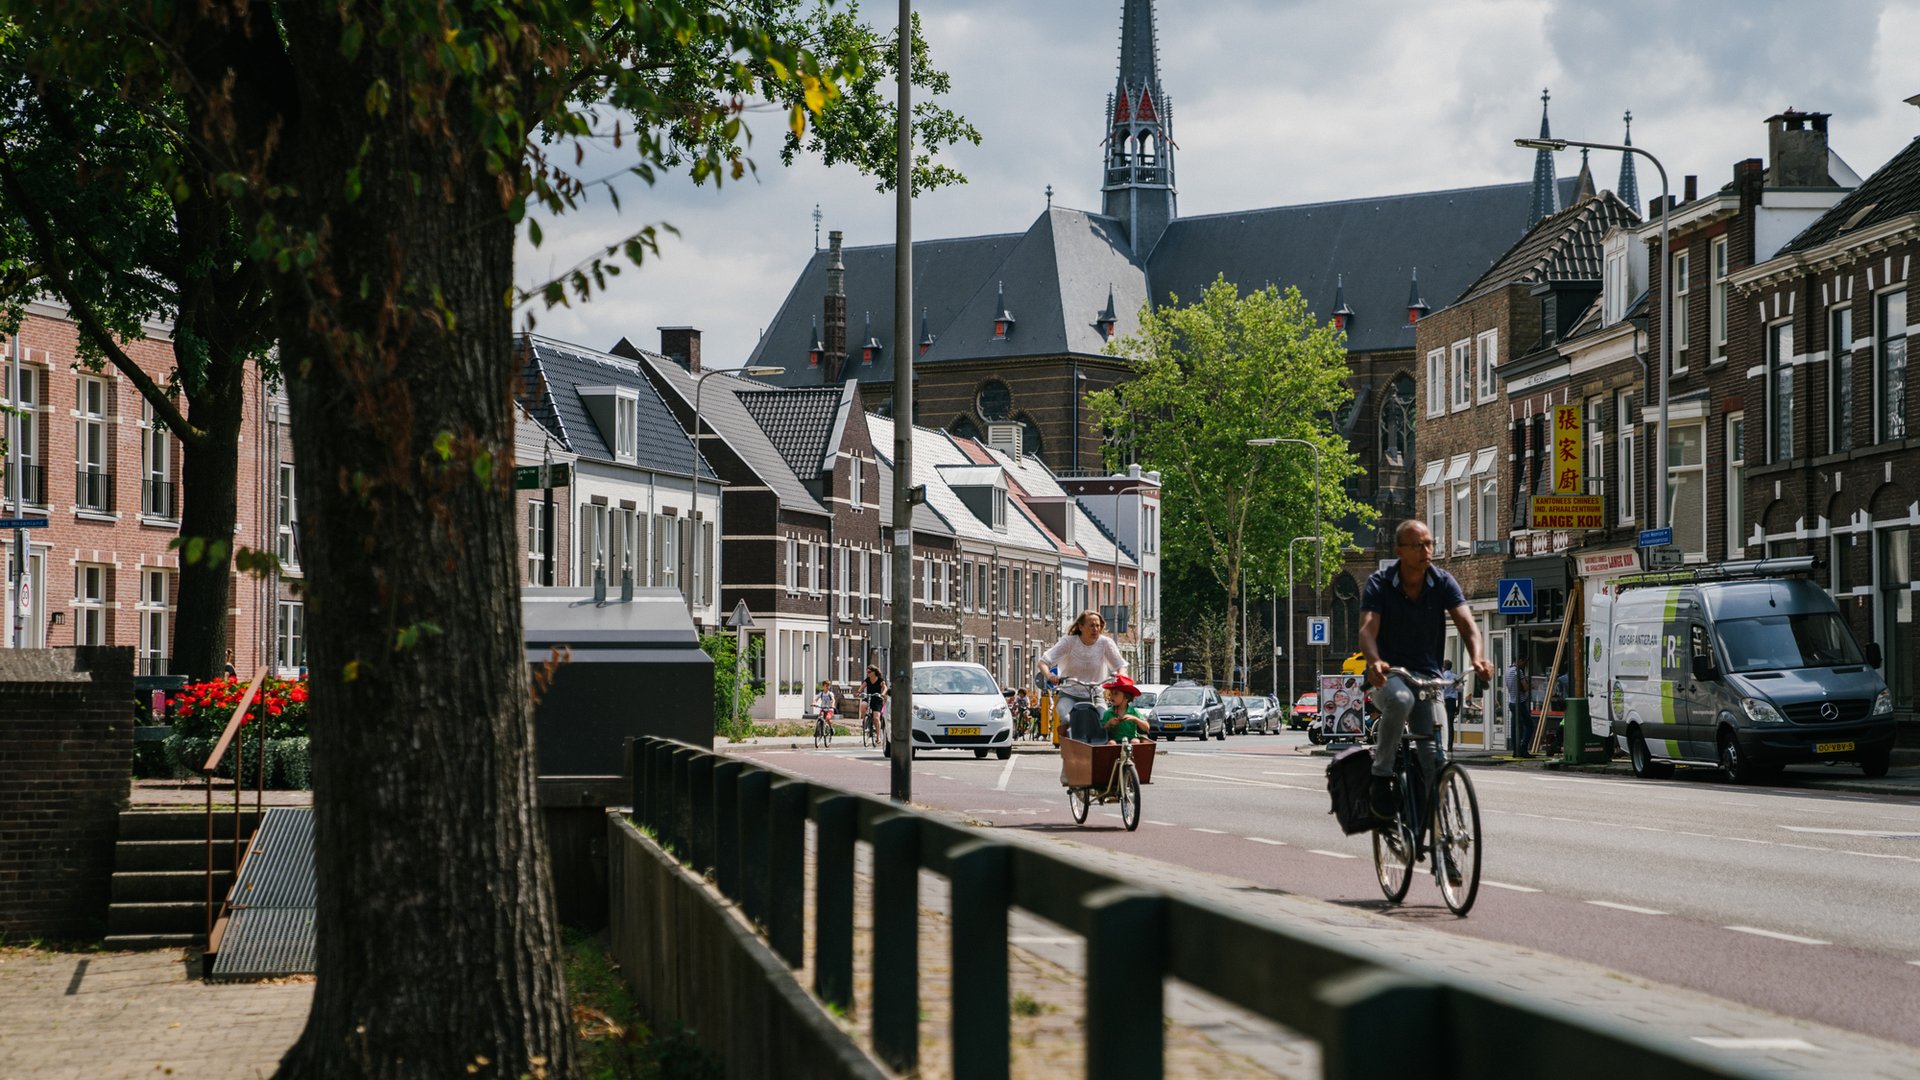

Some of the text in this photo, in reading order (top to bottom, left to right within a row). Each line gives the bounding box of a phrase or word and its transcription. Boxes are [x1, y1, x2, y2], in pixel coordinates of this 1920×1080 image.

[1533, 515, 1603, 528] LANGE KOK
[1315, 624, 1322, 634] P
